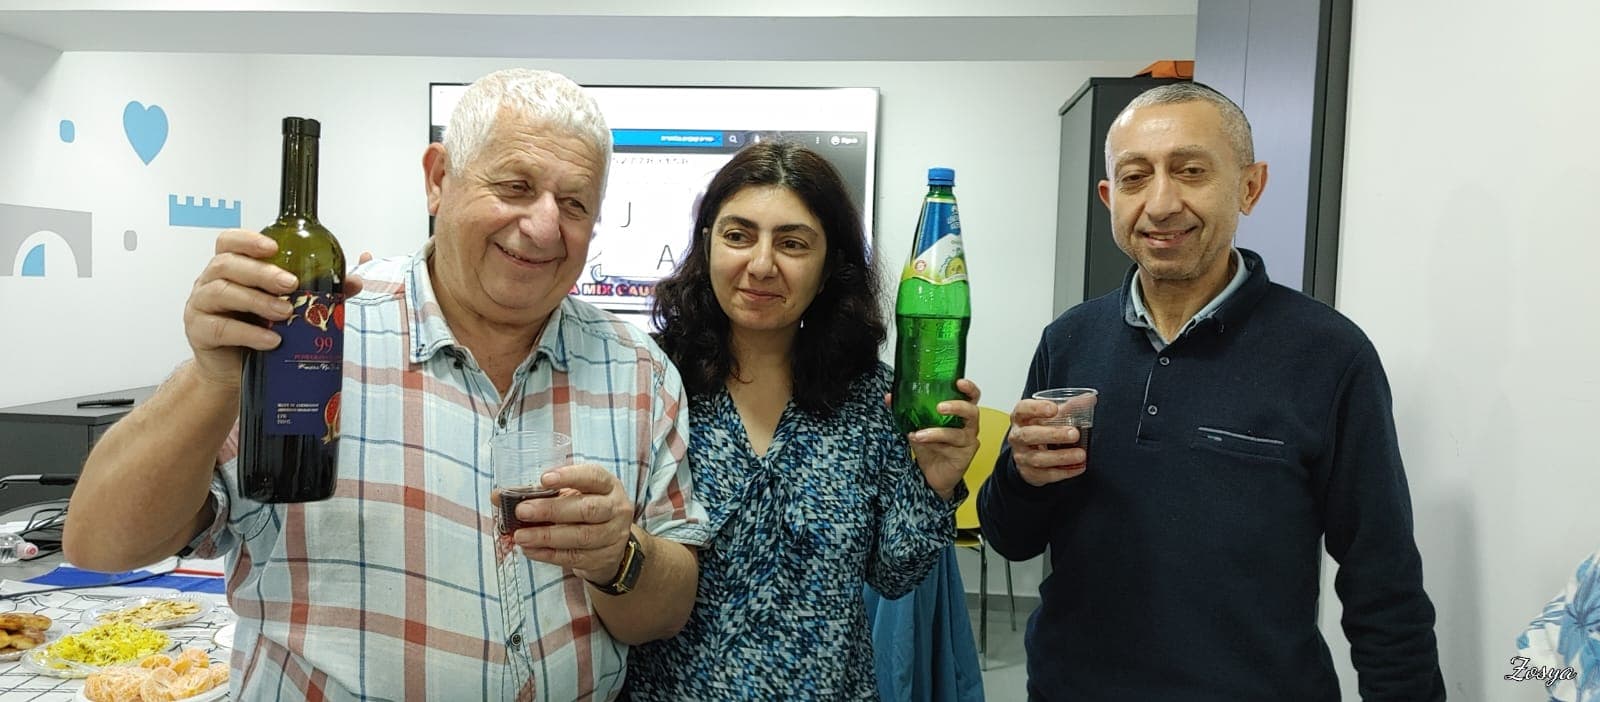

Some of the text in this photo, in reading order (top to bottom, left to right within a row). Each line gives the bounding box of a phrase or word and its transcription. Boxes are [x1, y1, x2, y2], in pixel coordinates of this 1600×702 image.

[656, 244, 677, 270] A
[582, 283, 614, 296] MIX
[314, 335, 334, 354] 99
